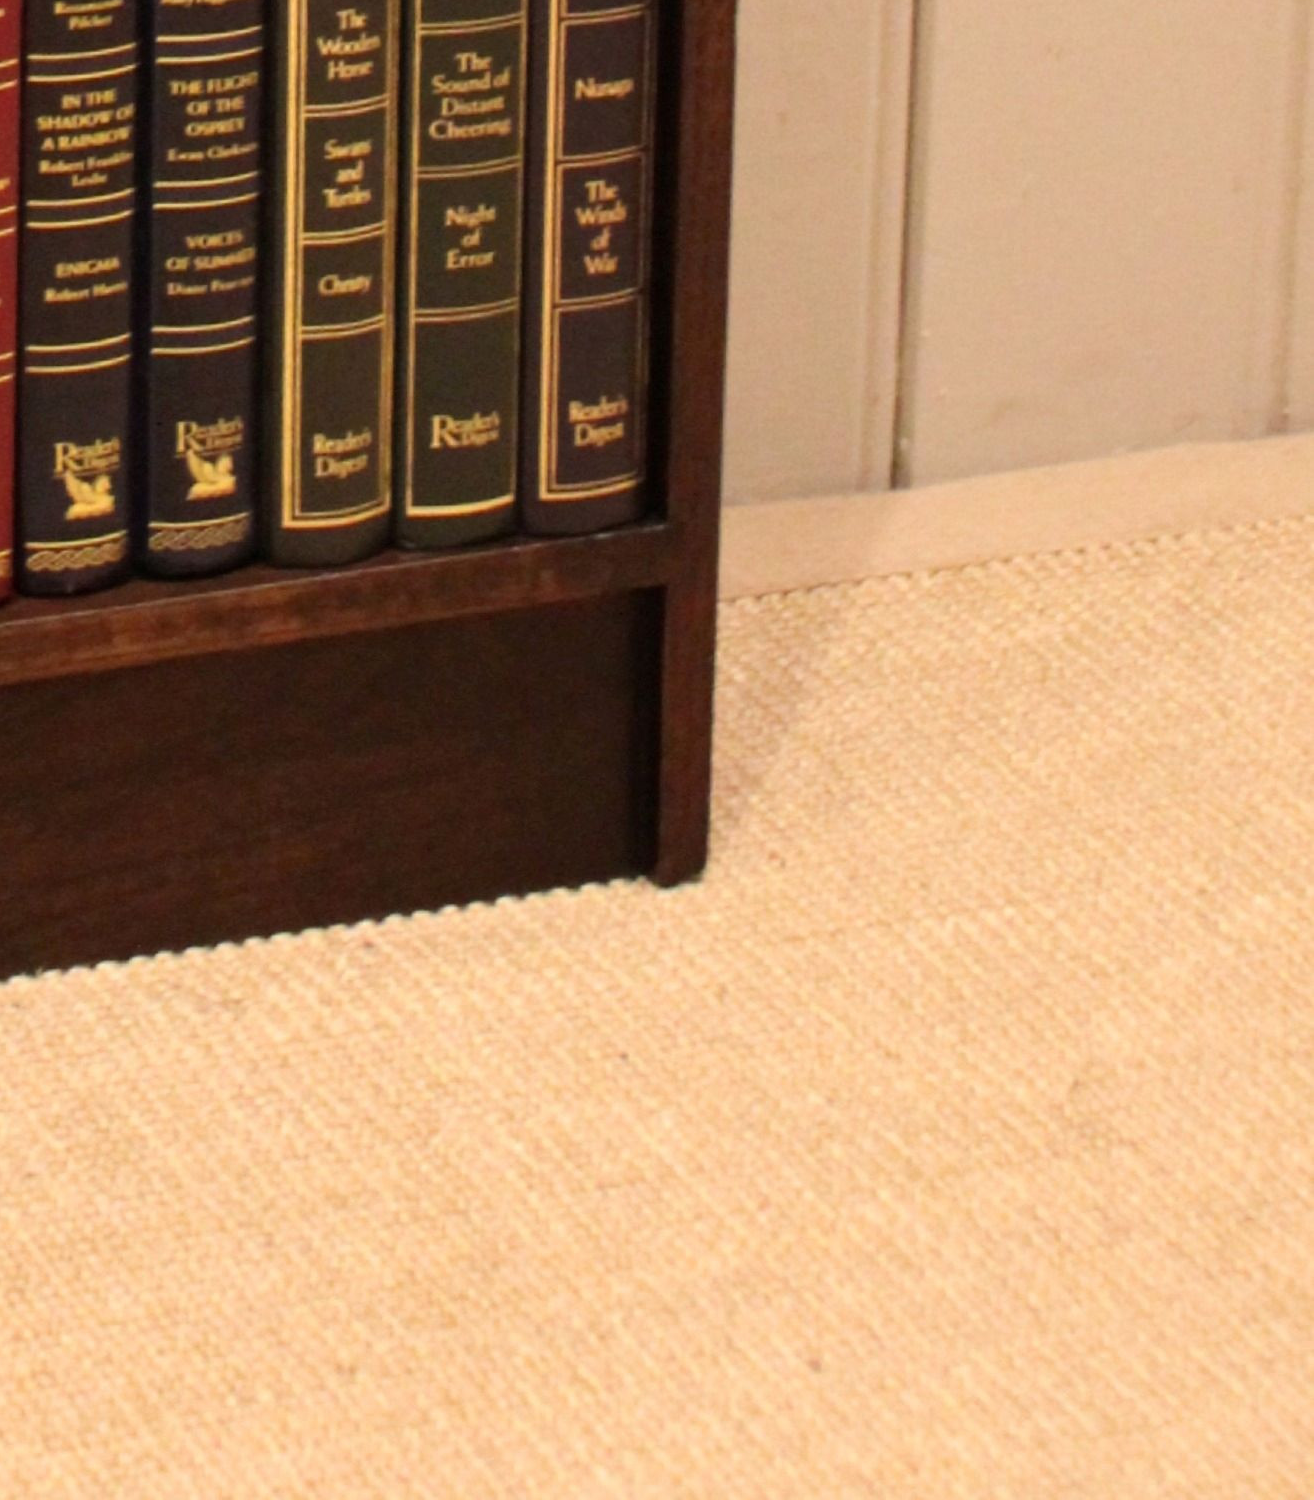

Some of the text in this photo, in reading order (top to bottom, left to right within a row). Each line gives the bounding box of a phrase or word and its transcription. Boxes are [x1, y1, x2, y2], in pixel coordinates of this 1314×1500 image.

[336, 8, 368, 30] The
[455, 51, 493, 73] The
[170, 79, 204, 96] THE
[431, 66, 511, 95] Sound of
[86, 87, 118, 107] THE
[441, 95, 506, 117] Distant
[37, 108, 115, 132] SHADOW
[41, 137, 55, 151] A
[336, 161, 365, 184] and
[585, 180, 619, 202] The
[444, 205, 497, 228] Night
[460, 226, 482, 247] of
[590, 228, 612, 251] of
[445, 248, 495, 270] Error
[583, 253, 619, 275] War
[573, 420, 624, 448] Digest
